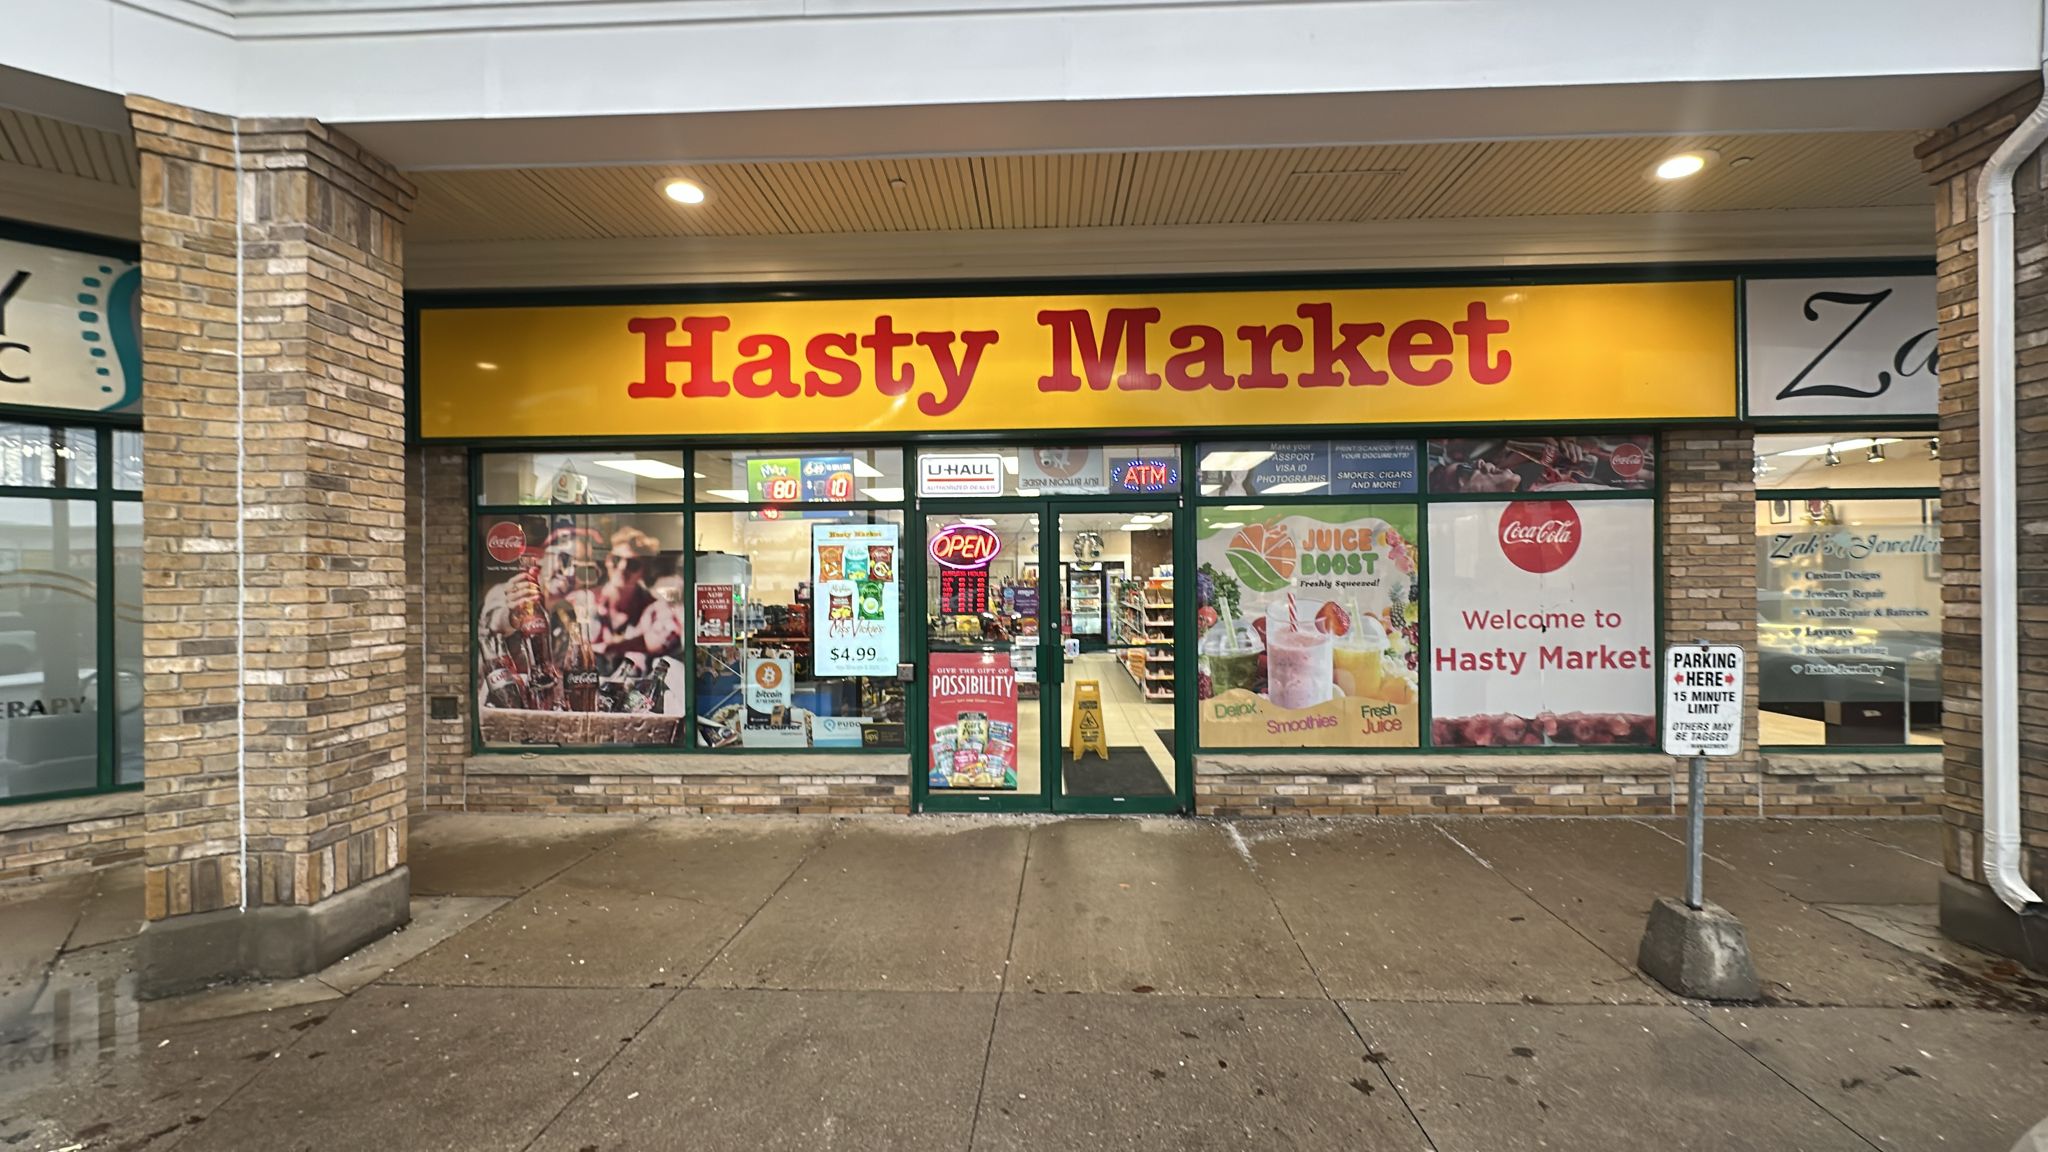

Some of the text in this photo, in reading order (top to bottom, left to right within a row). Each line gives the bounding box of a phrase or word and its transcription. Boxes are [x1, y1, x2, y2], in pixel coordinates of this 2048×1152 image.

[627, 302, 1512, 418] Hasty Market
[1271, 453, 1316, 462] ASSPORT
[1123, 464, 1168, 486] ATM
[1275, 464, 1308, 473] VISA ID
[1378, 471, 1413, 479] CIGARS
[1021, 478, 1048, 487] INSIDE
[1049, 478, 1083, 487] BITCOIN
[1256, 474, 1327, 484] PHOTOGRAPHS
[1351, 481, 1401, 489] AND MORE!
[773, 479, 798, 499] 80
[832, 478, 848, 498] 10
[1503, 519, 1576, 545] Coca-Cola
[933, 534, 993, 559] OPEN
[1302, 528, 1373, 552] JUICE
[1301, 552, 1379, 576] BOOST
[1805, 569, 1881, 582] Custom Designs
[1300, 578, 1380, 589] Freshly Squeezed!
[1806, 589, 1885, 602] Jewellery Repair
[1462, 609, 1622, 630] Welcome to
[1806, 607, 1930, 620] Watch Repair & Batteries
[1806, 627, 1854, 641] Layaways
[830, 647, 876, 663] $4.99
[1435, 645, 1652, 675] Hasty Market
[1674, 653, 1736, 668] PARKING
[959, 667, 975, 675] THE
[977, 667, 996, 675] GIFT
[998, 667, 1009, 675] OF
[932, 675, 1014, 698] POSSIBILITY
[1686, 671, 1723, 687] HERE
[755, 689, 783, 698] bitcoin
[1673, 691, 1736, 702] 15 MINUTE
[0, 696, 87, 720] RAPY
[1214, 701, 1258, 719] Detox
[1360, 703, 1398, 719] Fresh
[1688, 703, 1720, 714] LIMIT
[1266, 715, 1338, 735] Smoothies
[1361, 718, 1404, 735] Juice
[1672, 722, 1734, 731] OTHERS MAY
[1675, 732, 1729, 741] BE TAGGED
